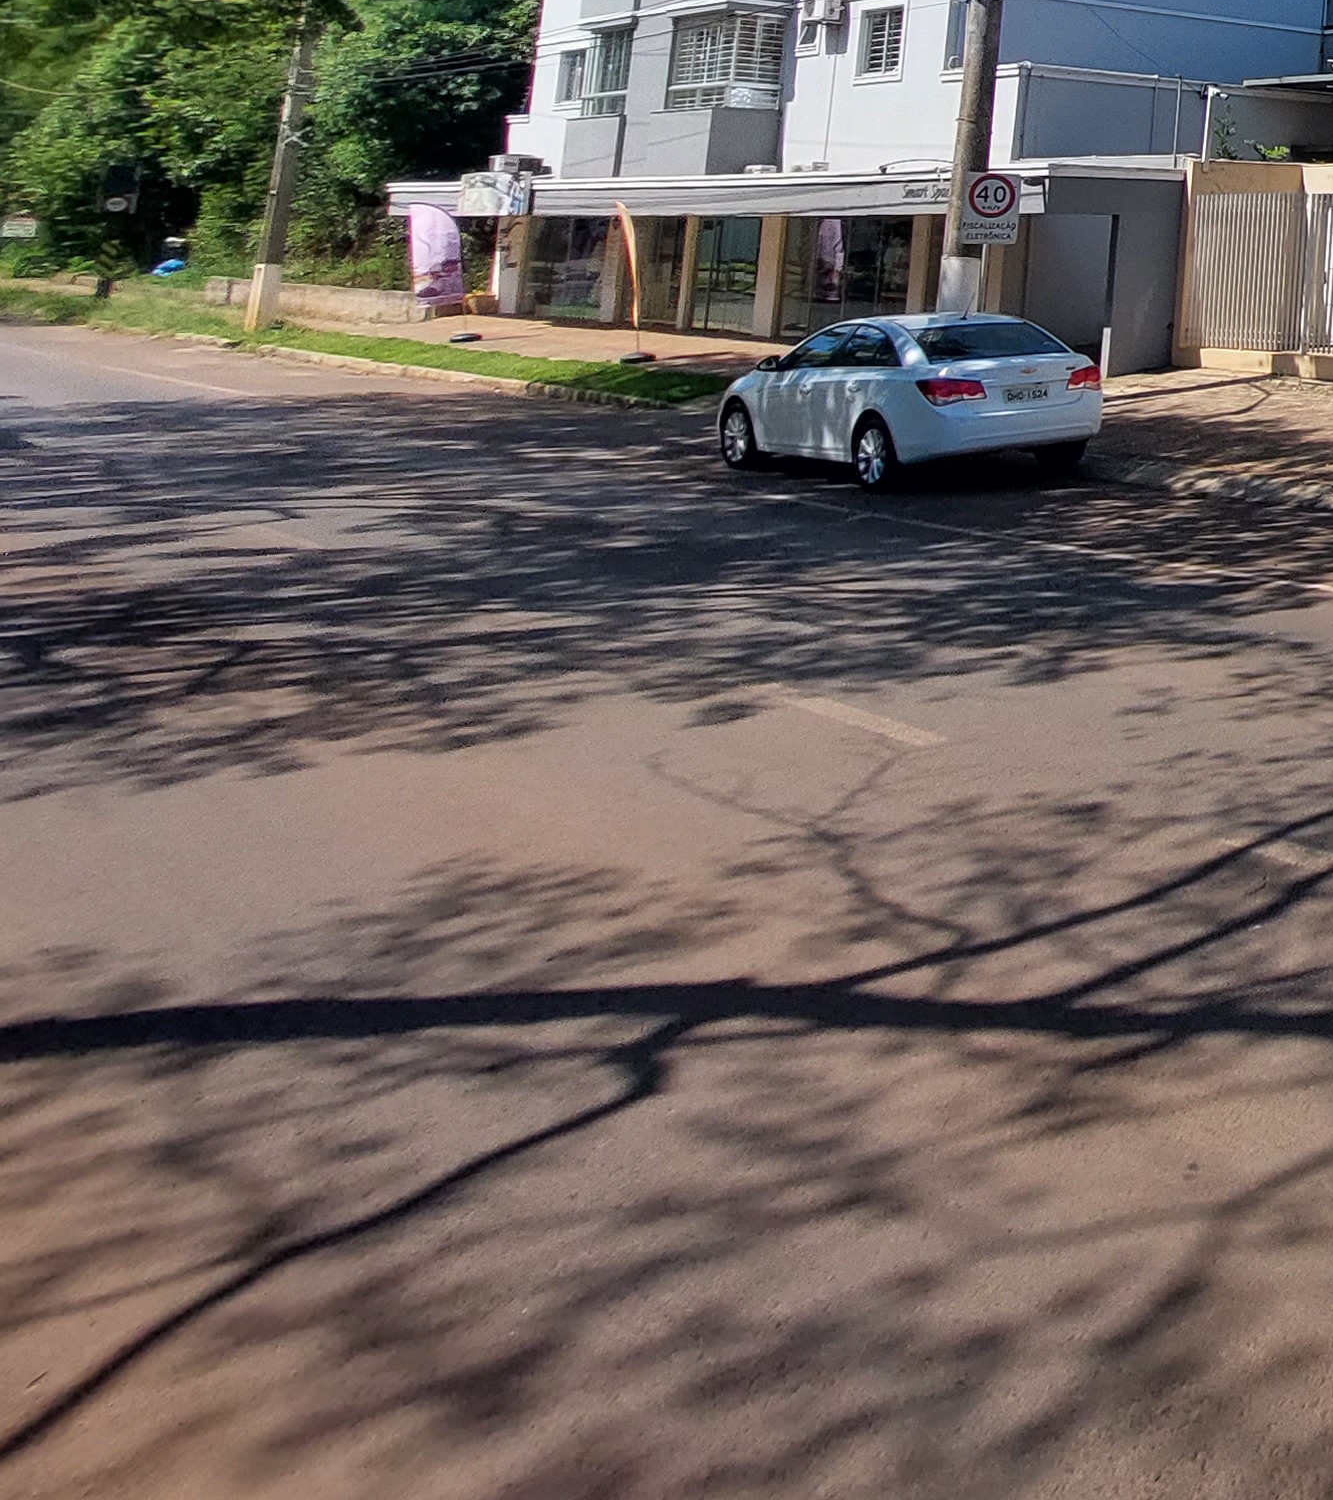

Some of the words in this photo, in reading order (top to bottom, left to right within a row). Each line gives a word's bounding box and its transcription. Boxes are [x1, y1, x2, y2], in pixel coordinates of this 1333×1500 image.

[975, 185, 1007, 204] 40
[962, 220, 1017, 232] FISCALIZAÇÃO
[965, 231, 1012, 241] ELETRÔNICA
